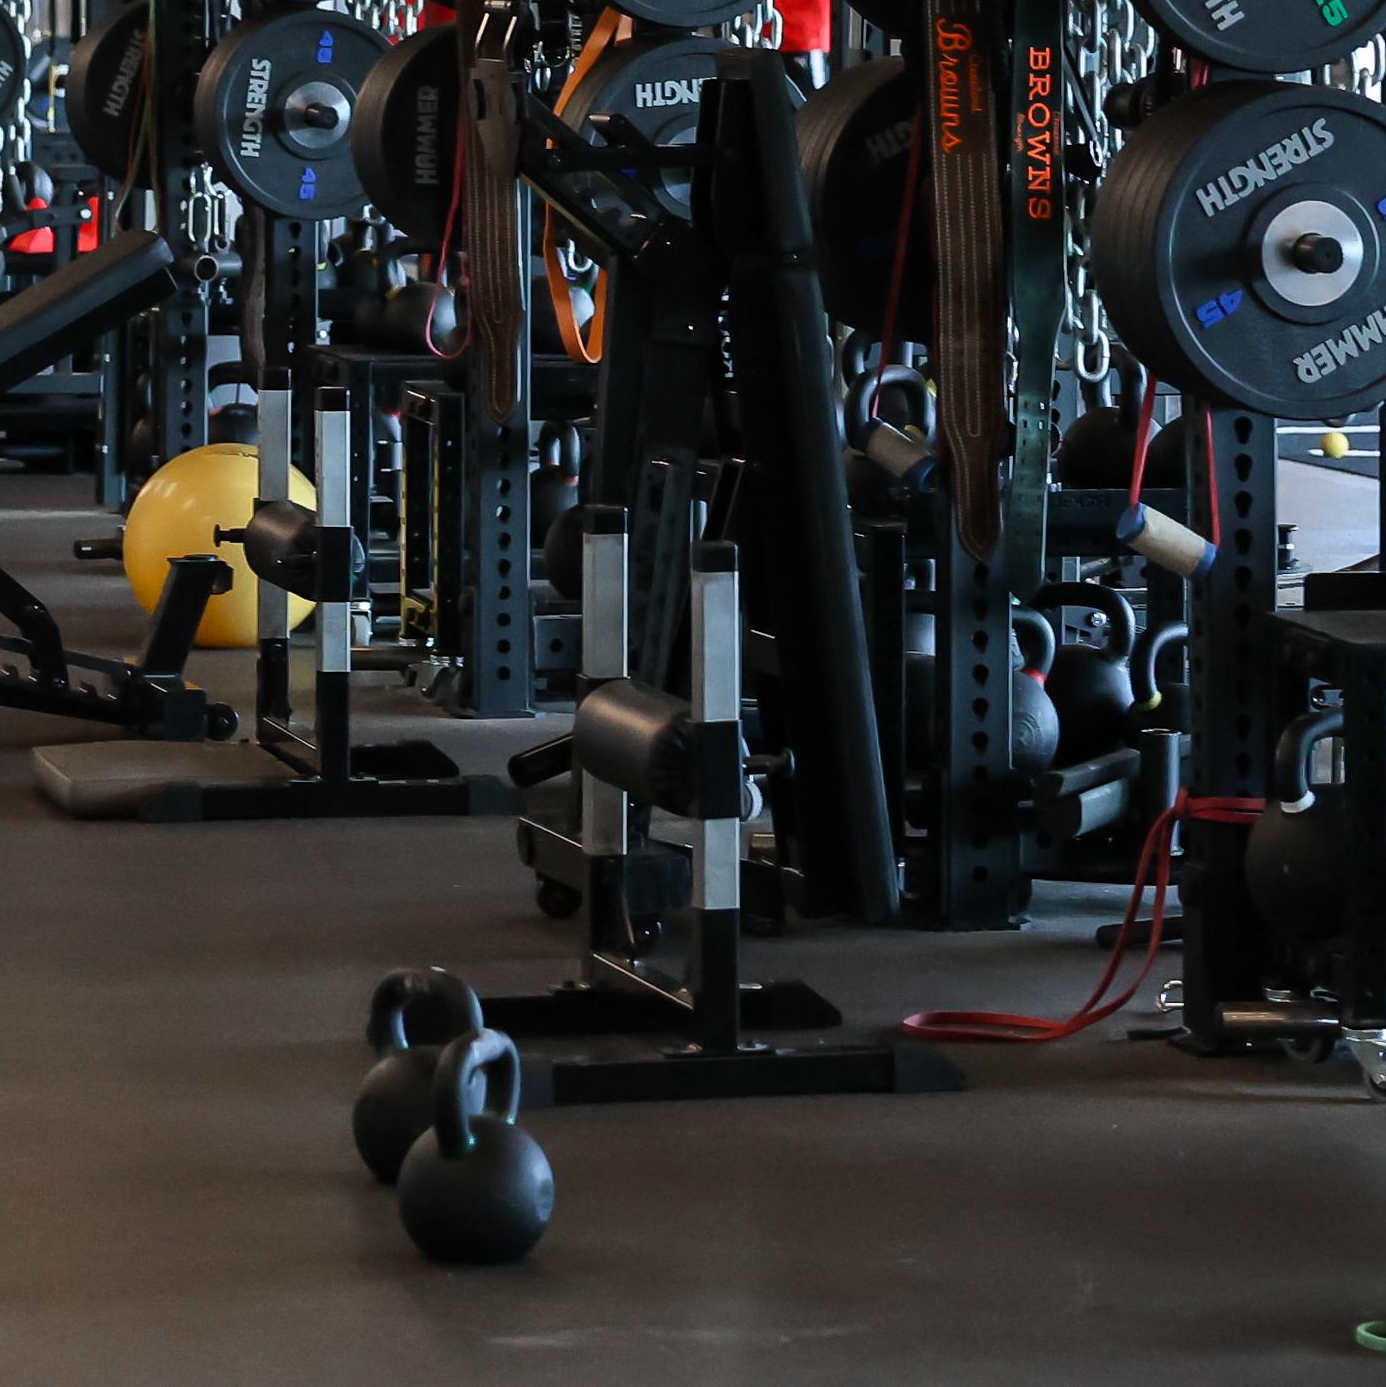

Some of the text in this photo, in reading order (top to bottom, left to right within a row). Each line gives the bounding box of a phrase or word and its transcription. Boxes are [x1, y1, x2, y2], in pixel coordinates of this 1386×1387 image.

[239, 58, 272, 159] STRENGTH
[414, 84, 441, 187] HAMMER
[934, 16, 975, 154] Browns
[1027, 45, 1054, 221] BROWNS
[299, 165, 317, 201] 45
[1194, 117, 1336, 218] STRENGTH
[1195, 288, 1243, 329] 45
